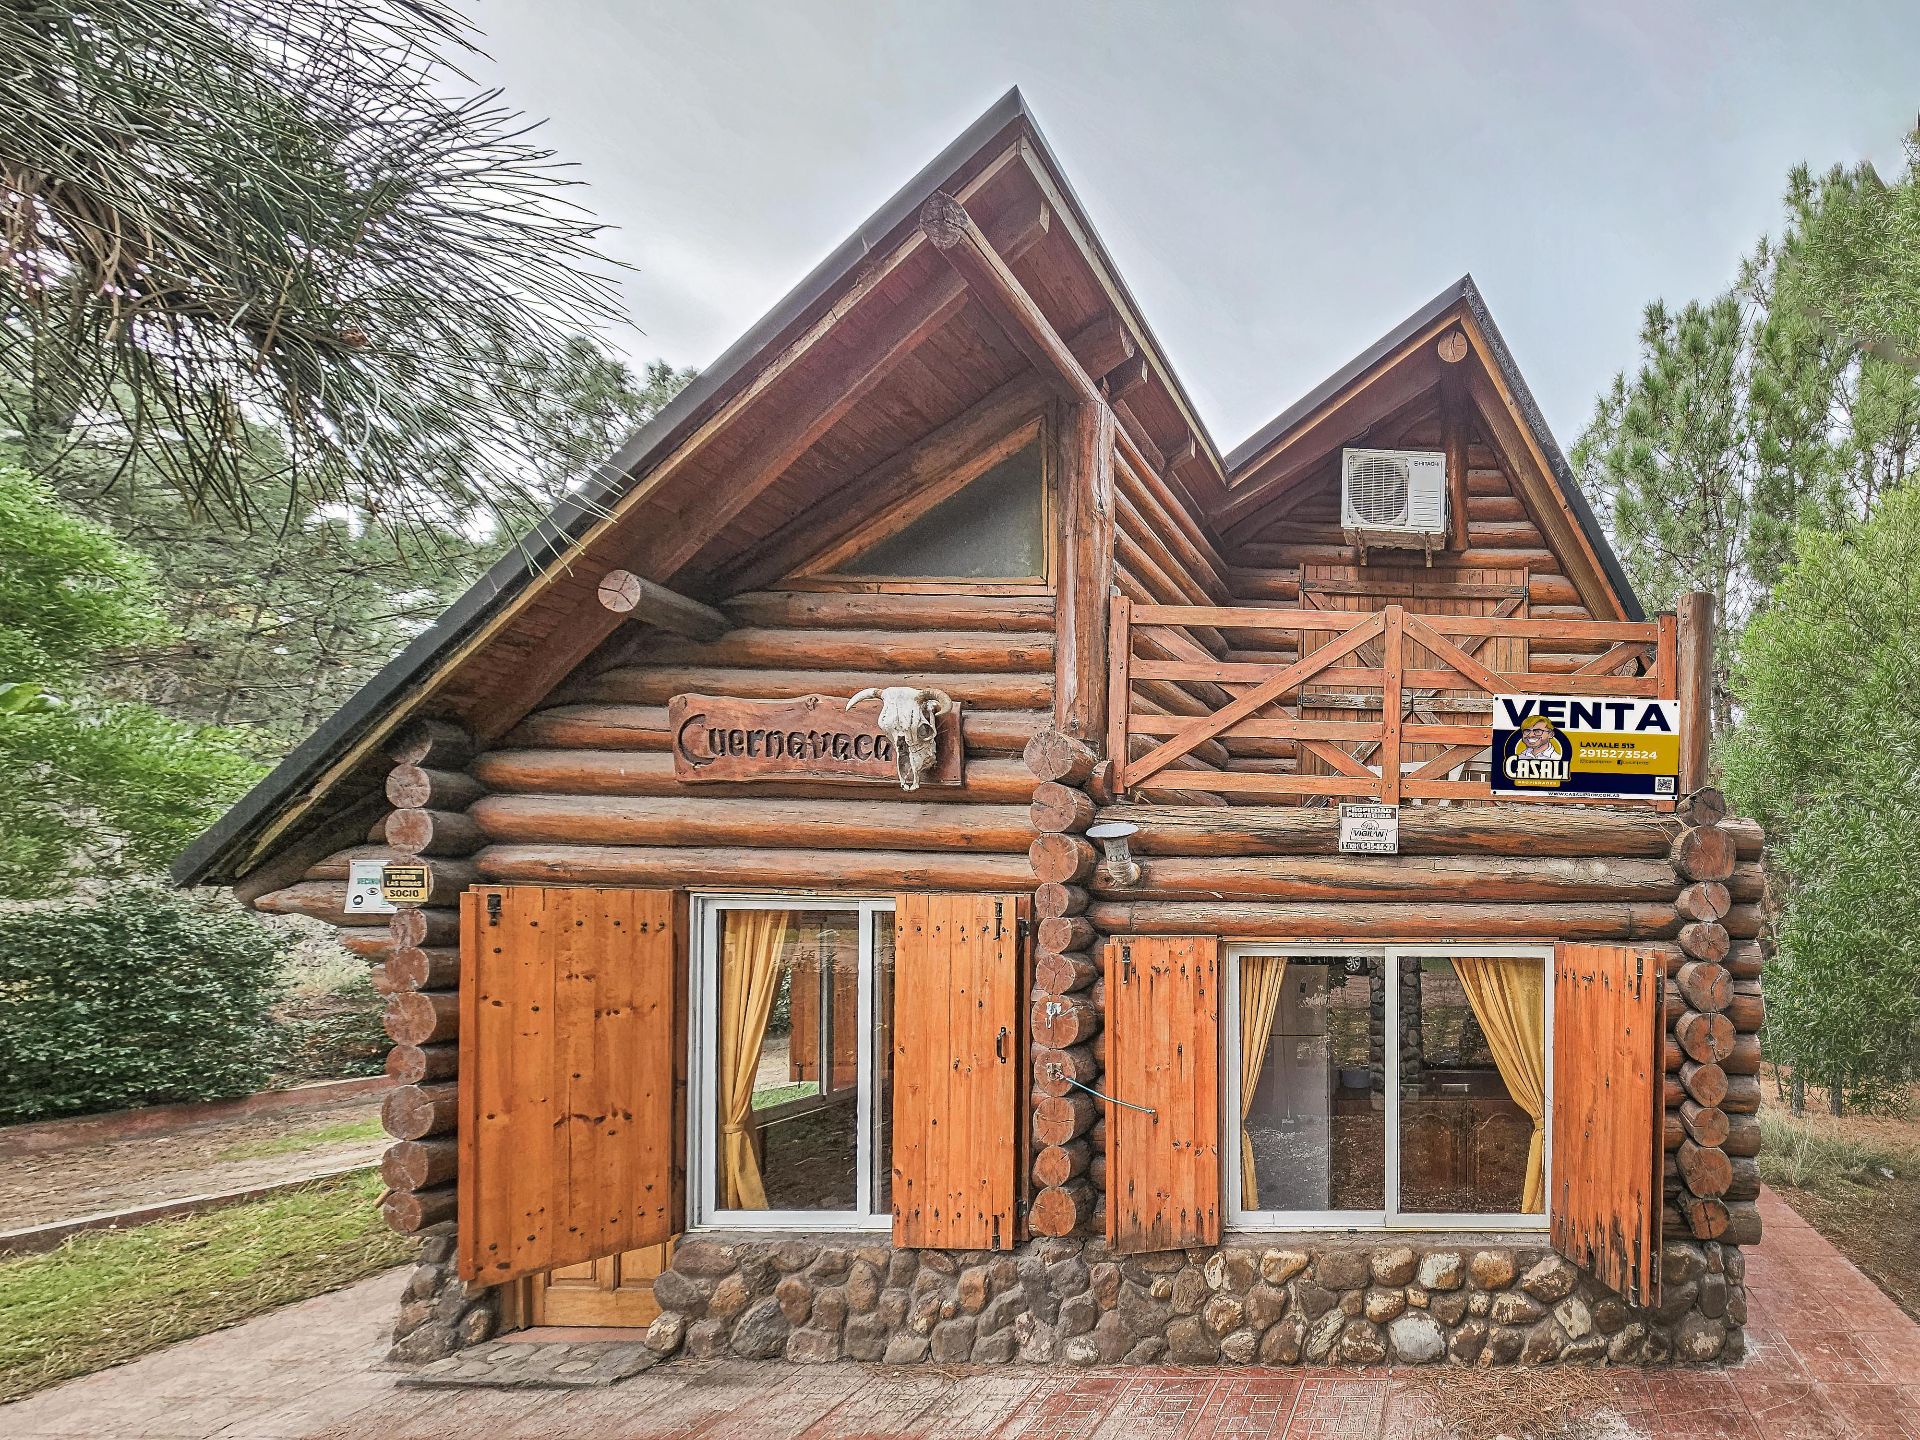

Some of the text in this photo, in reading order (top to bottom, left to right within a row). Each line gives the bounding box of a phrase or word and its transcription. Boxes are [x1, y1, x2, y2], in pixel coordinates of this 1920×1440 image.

[1502, 698, 1671, 732] VENTA
[677, 714, 893, 767] Cuernavaca
[1580, 741, 1619, 749] LAVALLE
[1579, 749, 1658, 760] 2915273524
[1505, 756, 1569, 780] CASALI
[389, 889, 419, 898] SOCIO
